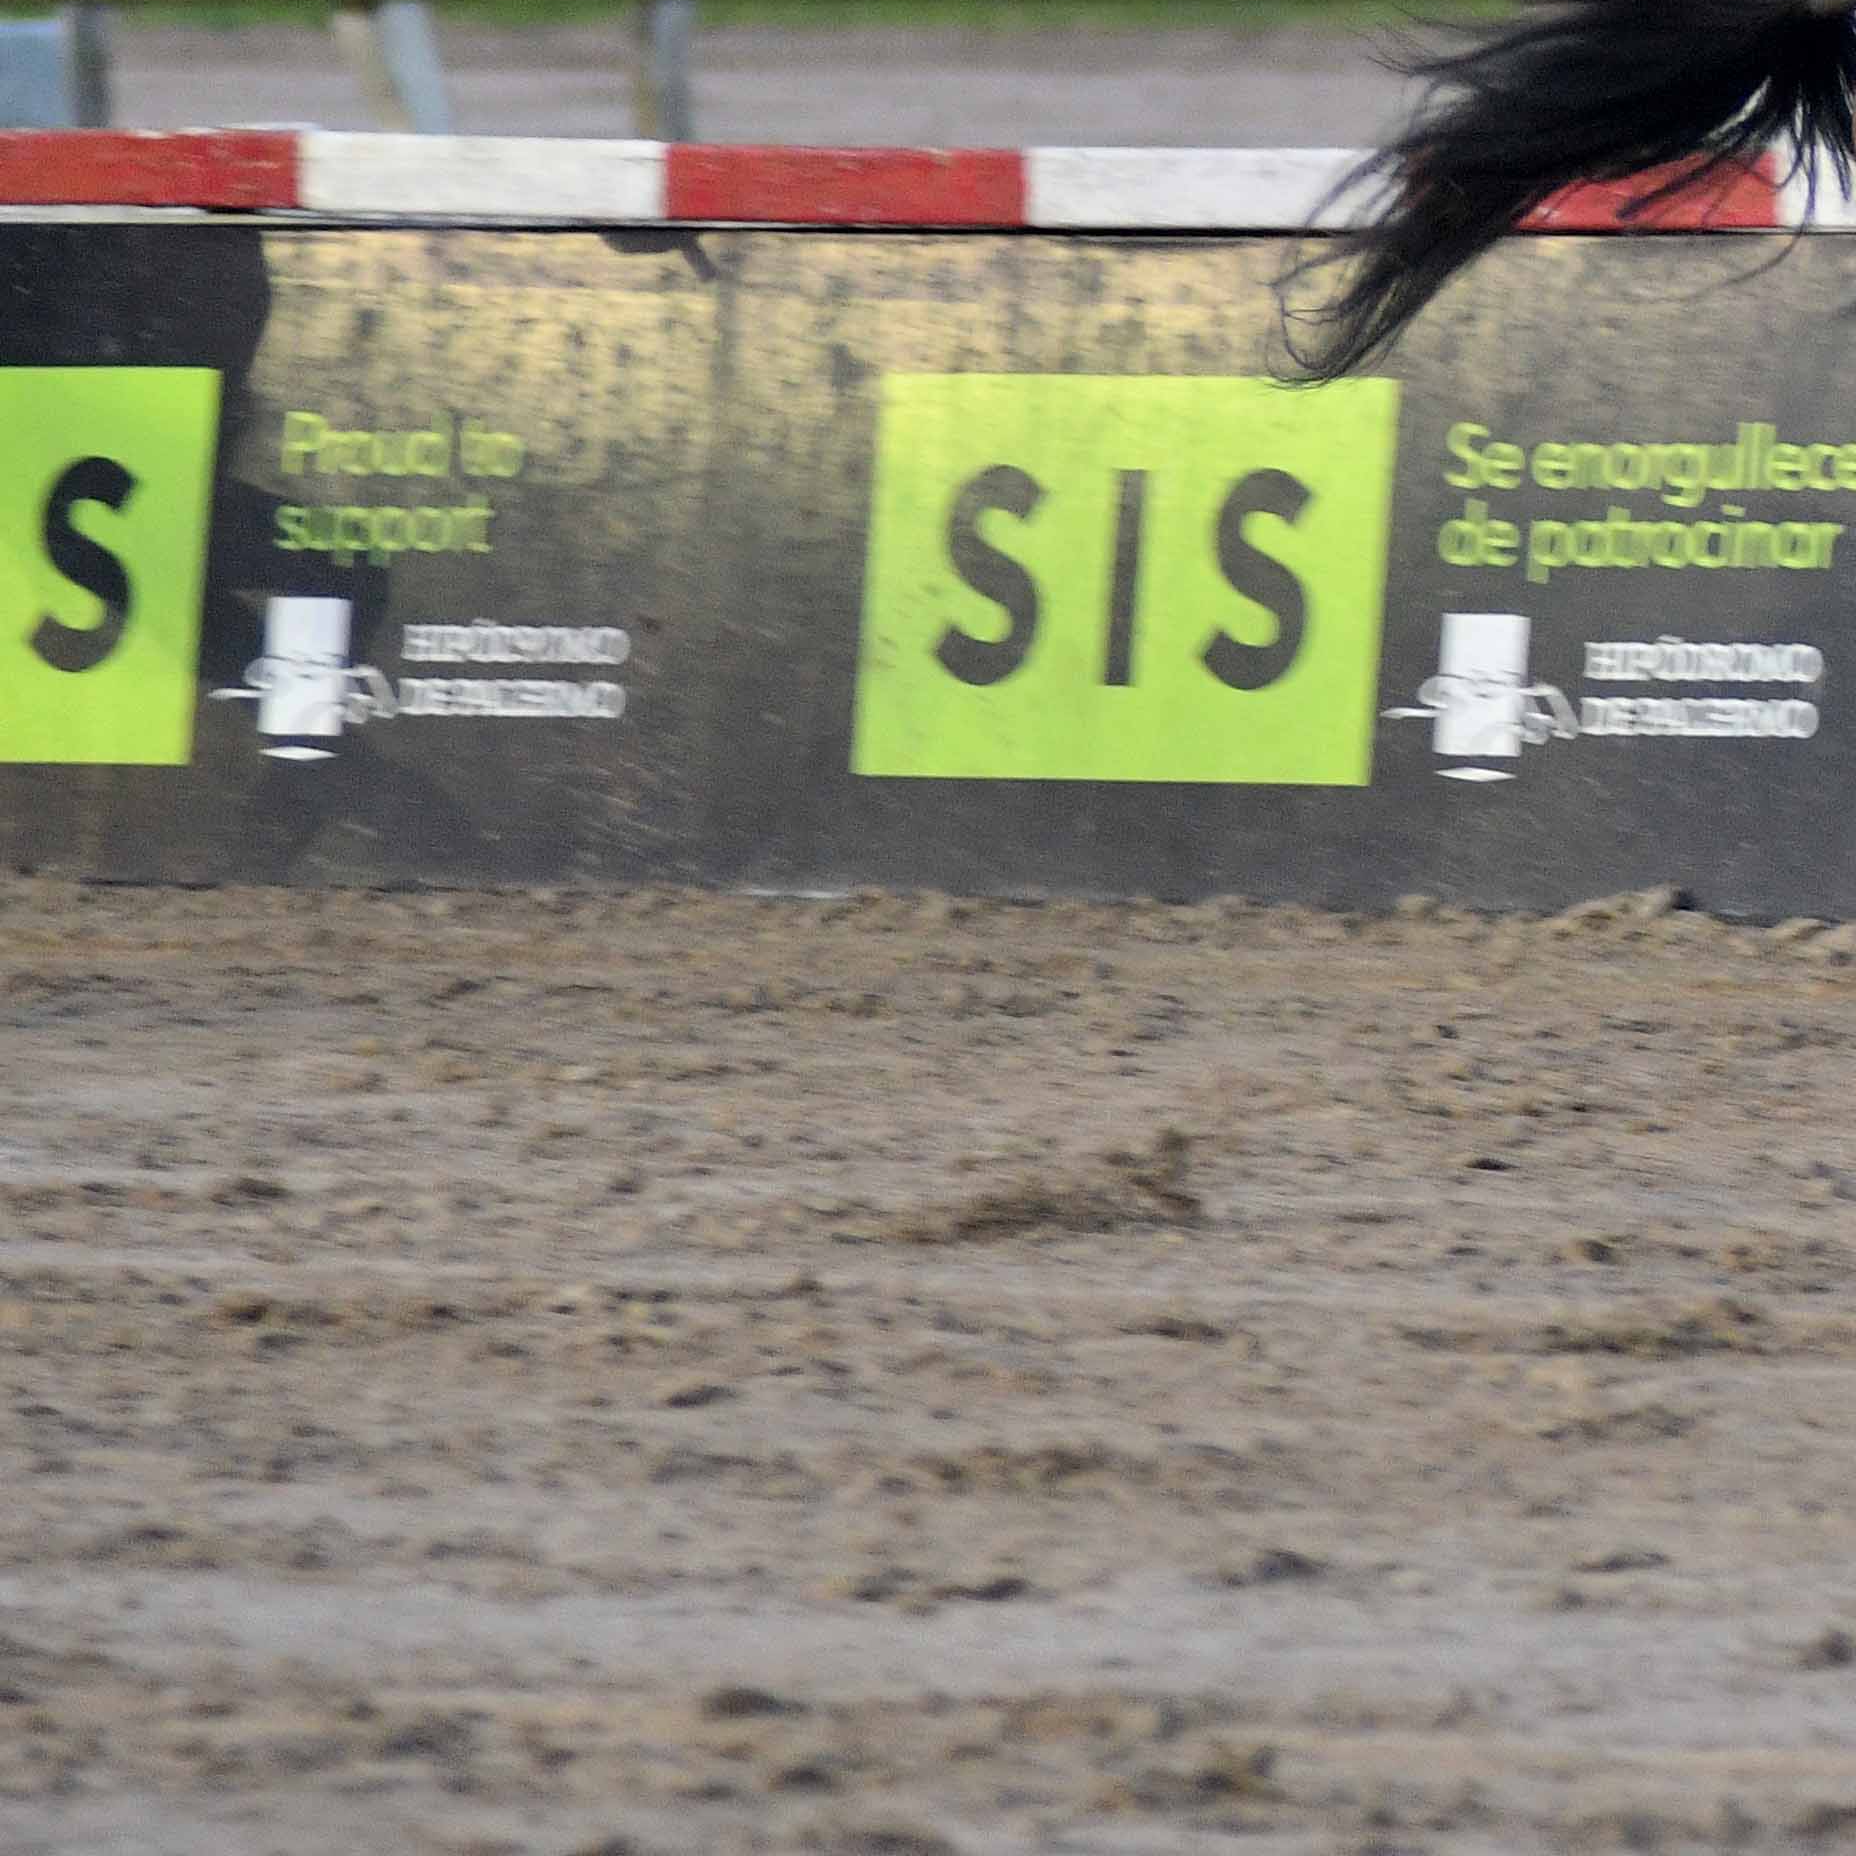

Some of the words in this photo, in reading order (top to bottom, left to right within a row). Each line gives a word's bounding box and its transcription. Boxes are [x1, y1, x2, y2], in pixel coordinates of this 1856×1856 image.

[281, 410, 454, 477] Proud
[460, 418, 526, 478] to
[1443, 421, 1525, 491] Se
[274, 494, 495, 568] support
[1438, 499, 1520, 567] de
[1526, 504, 1846, 584] patrocinar
[934, 463, 1314, 691] SIS
